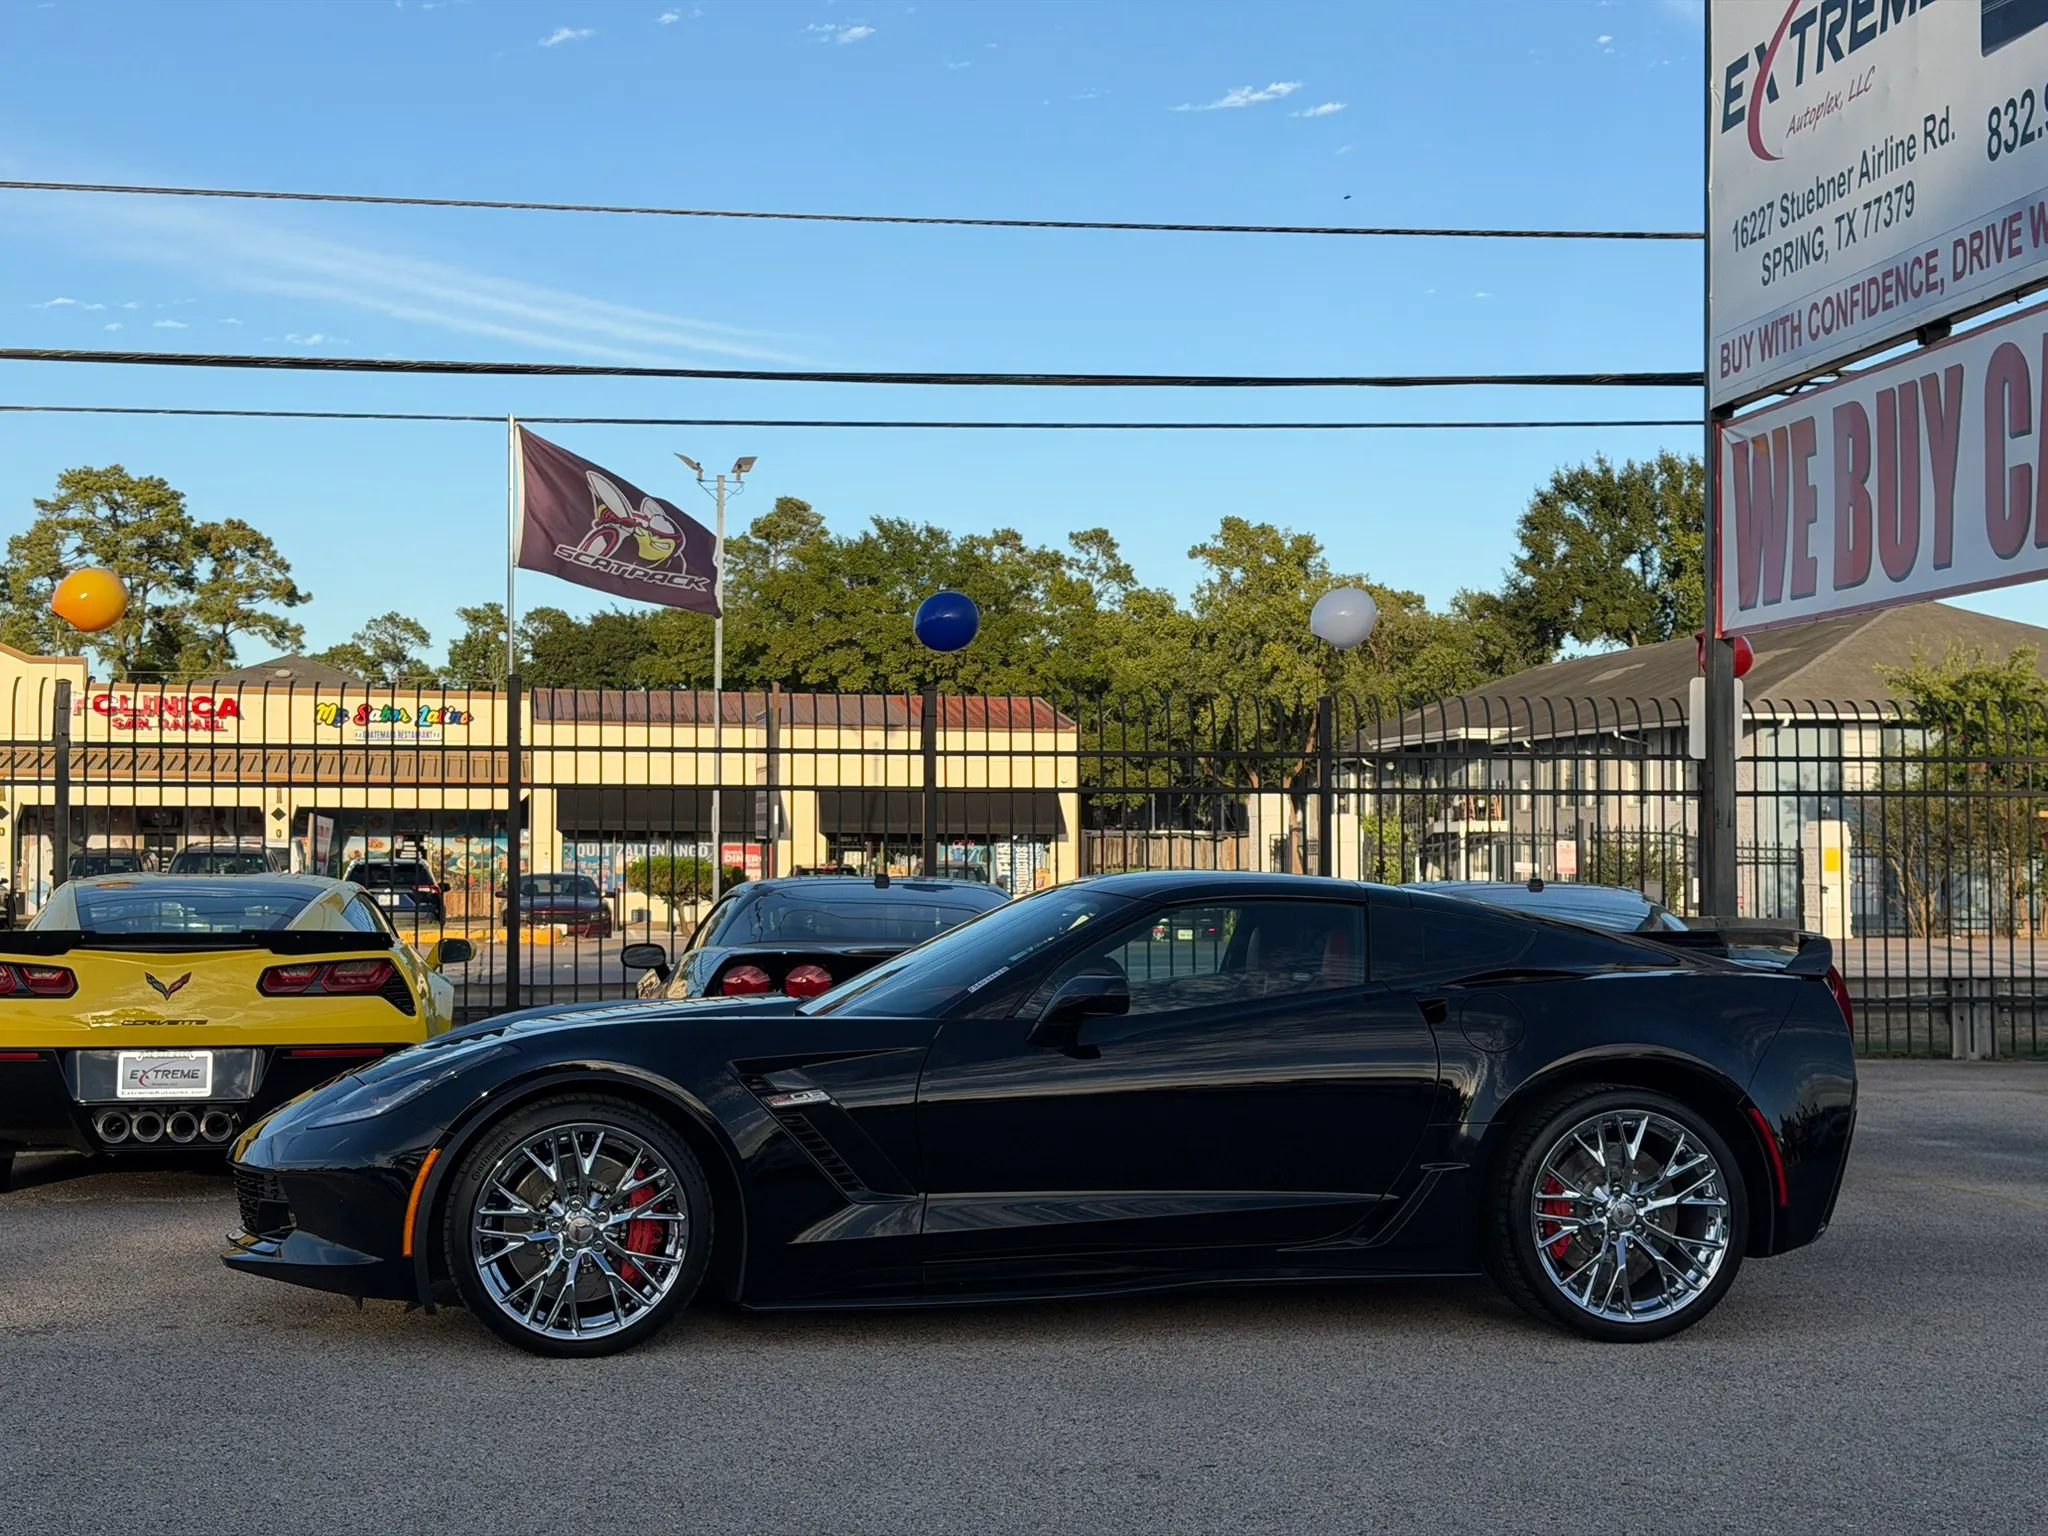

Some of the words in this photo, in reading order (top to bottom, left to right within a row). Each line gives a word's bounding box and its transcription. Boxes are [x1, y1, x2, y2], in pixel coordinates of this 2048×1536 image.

[1721, 0, 1939, 134] EXTRE
[1785, 90, 1844, 138] Autoplex,
[1847, 65, 1876, 102] LLC
[1986, 82, 2048, 162] 832.
[1732, 200, 1775, 252] 16227
[1780, 166, 1854, 228] Stuebner
[1858, 133, 1917, 189] Airline
[1923, 105, 1956, 155] Rd.
[1761, 225, 1829, 287] SPRING,
[1834, 207, 1858, 252] TX
[1863, 180, 1916, 239] 77379
[1720, 330, 1754, 379] BUY
[1758, 309, 1802, 362] WITH
[1807, 248, 1945, 342] CONFIDENCE,
[1952, 210, 2023, 282] DRIVE
[1731, 415, 1818, 612] WE
[1832, 363, 1965, 592] BUY
[1983, 331, 2048, 561] C
[353, 703, 412, 727] Sabor
[415, 704, 475, 727] Latino
[397, 730, 434, 739] RESTARANT
[129, 1068, 201, 1081] EXTREME
